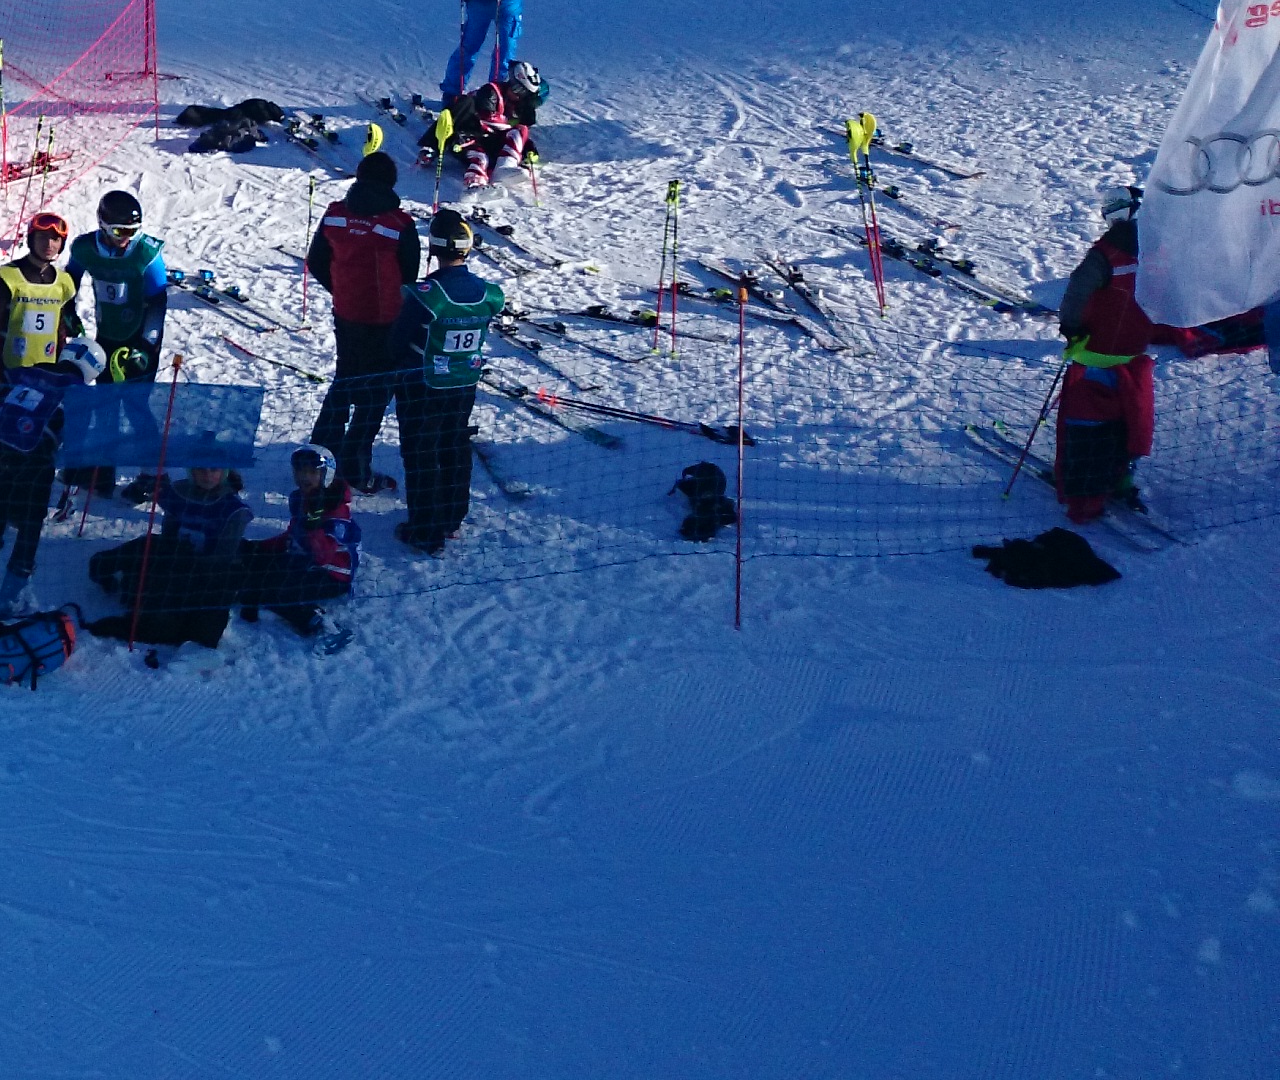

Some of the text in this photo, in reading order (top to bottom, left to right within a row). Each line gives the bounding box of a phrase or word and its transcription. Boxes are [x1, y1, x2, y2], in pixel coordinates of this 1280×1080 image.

[107, 285, 116, 301] 9
[35, 313, 45, 331] 5
[452, 332, 474, 350] 18
